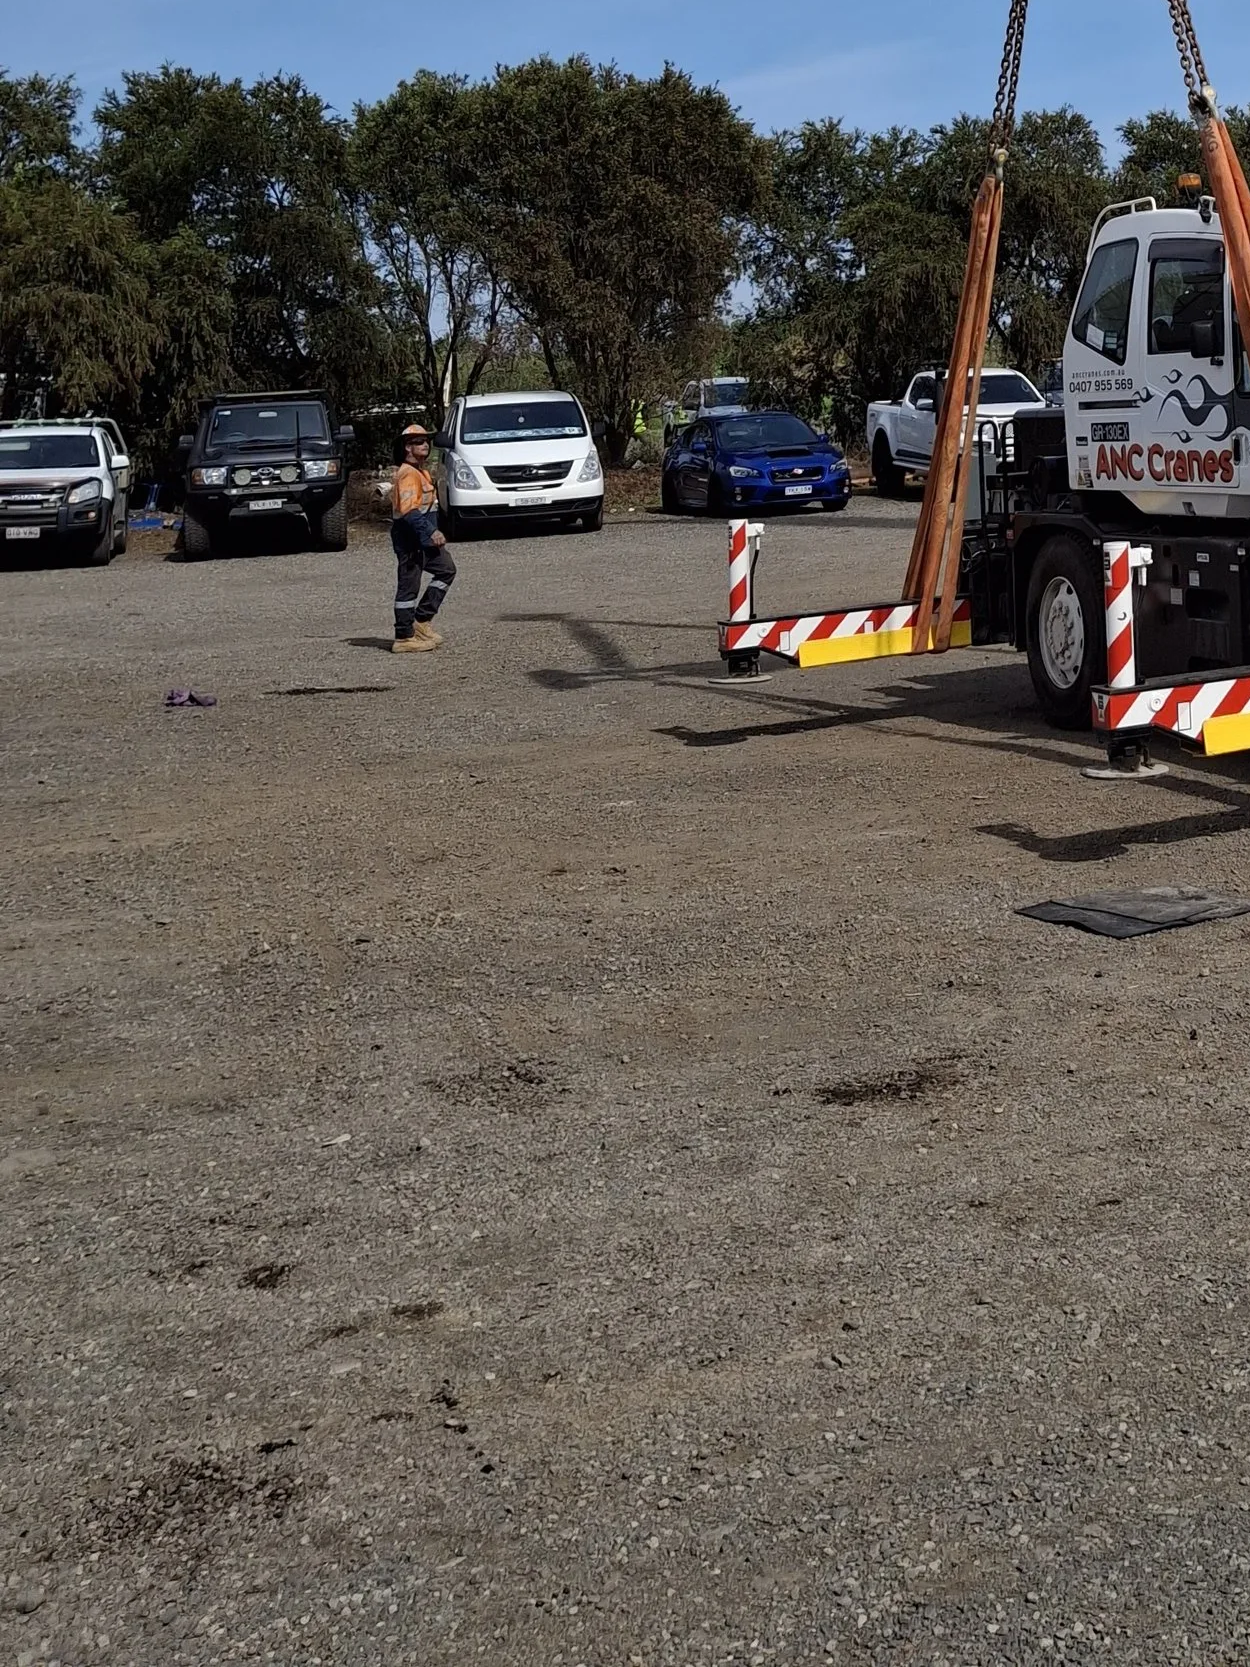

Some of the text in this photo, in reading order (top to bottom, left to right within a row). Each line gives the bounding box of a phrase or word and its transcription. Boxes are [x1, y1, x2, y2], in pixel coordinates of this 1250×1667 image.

[1071, 368, 1126, 379] anccranes.com.au
[1069, 378, 1134, 393] 0407 955 569
[1091, 424, 1129, 441] GR-130EX
[1096, 443, 1145, 481] ANC
[1147, 443, 1235, 483] Cranes
